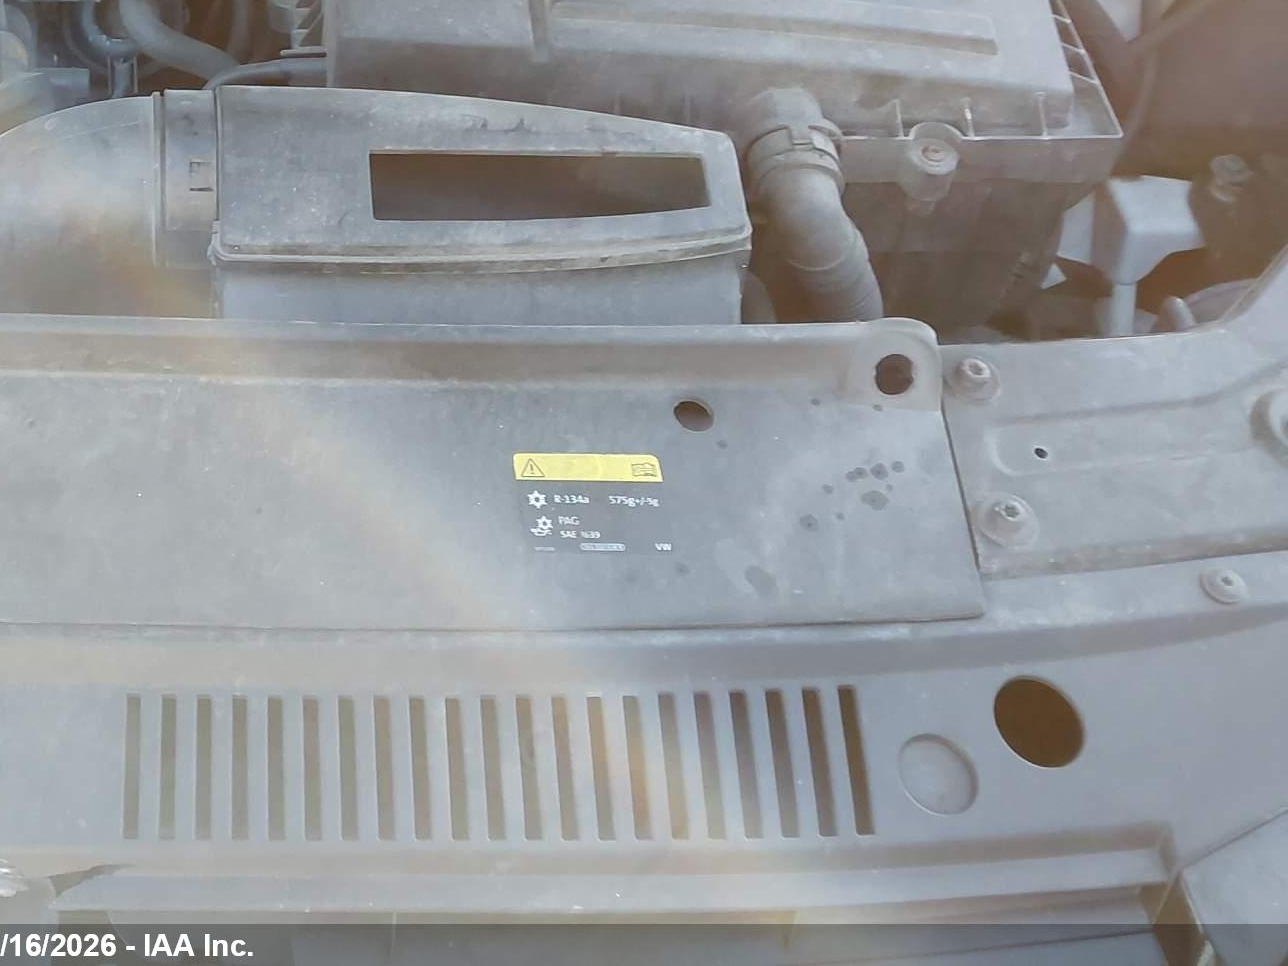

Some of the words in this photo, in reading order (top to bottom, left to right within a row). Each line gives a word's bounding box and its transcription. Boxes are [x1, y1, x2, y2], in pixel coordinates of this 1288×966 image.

[553, 494, 591, 504] R-134a
[558, 516, 581, 525] PAG
[560, 530, 578, 539] SAE
[654, 543, 673, 552] VW
